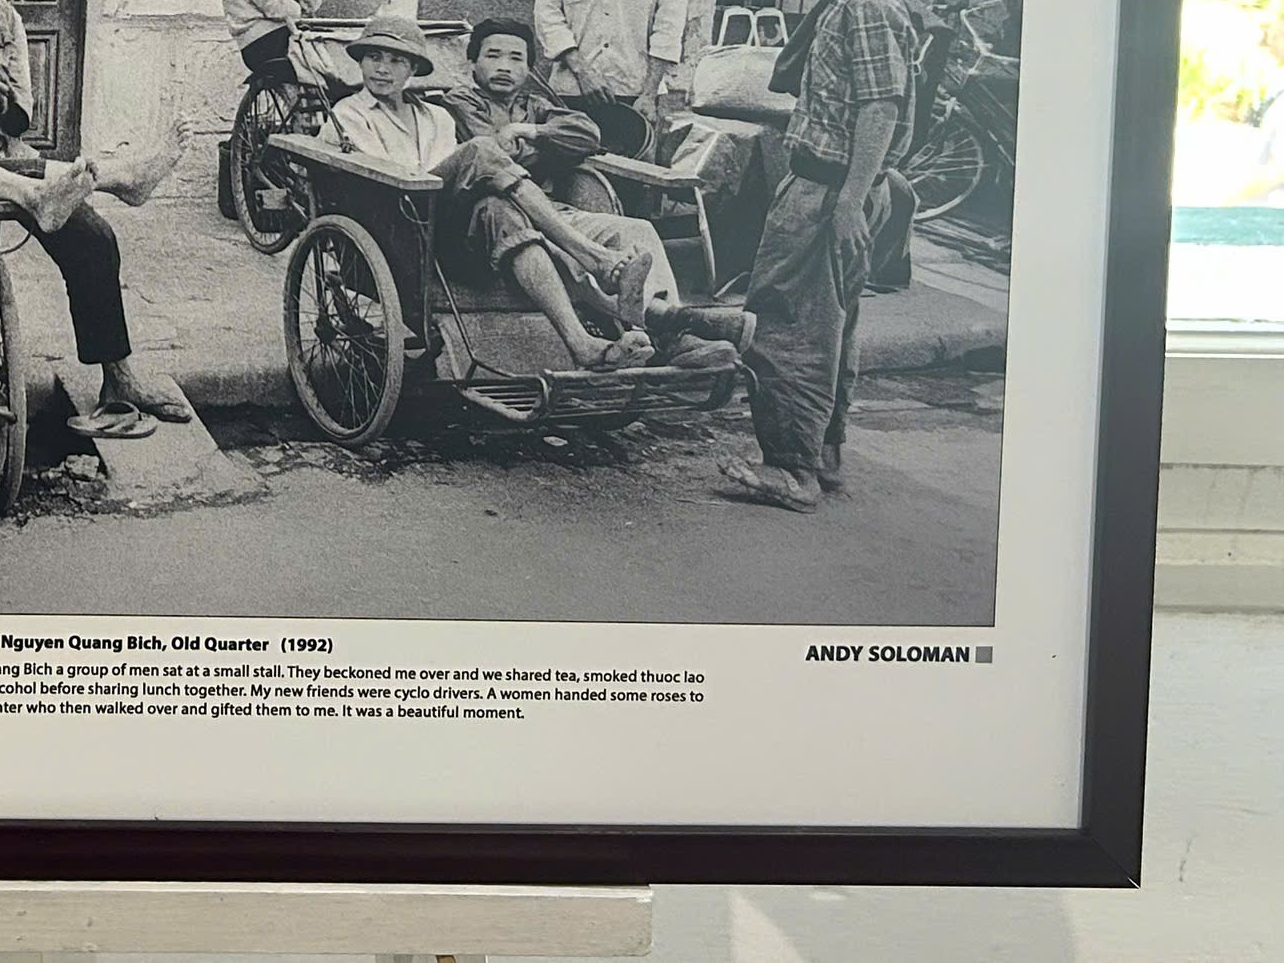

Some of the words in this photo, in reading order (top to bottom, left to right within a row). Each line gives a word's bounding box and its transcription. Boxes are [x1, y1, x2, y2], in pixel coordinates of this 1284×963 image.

[1, 635, 64, 653] Nguyen
[68, 635, 123, 653] Quang
[127, 635, 167, 652] Bich,
[171, 636, 200, 650] Old
[204, 637, 269, 652] Quarter
[281, 637, 333, 654] (1992)
[805, 645, 863, 662] ANDY
[868, 645, 970, 663] SOLOMAN
[24, 662, 52, 675] Bich
[56, 666, 63, 675] a
[66, 666, 108, 679] group
[112, 663, 126, 676] of
[129, 666, 159, 677] men
[162, 665, 183, 677] sat
[185, 665, 200, 677] at
[202, 667, 210, 677] a
[213, 664, 249, 677] small
[252, 665, 284, 678] stall.
[288, 665, 321, 682] They
[324, 665, 391, 679] beckoned
[395, 670, 416, 680] me
[419, 670, 450, 680] over
[453, 667, 479, 680] and
[482, 671, 502, 681] we
[505, 668, 551, 681] shared
[555, 670, 580, 683] tea,
[583, 669, 637, 682] smoked
[640, 669, 680, 683] thuoc
[684, 670, 705, 683] lao
[40, 681, 85, 695] before
[88, 682, 138, 698] sharing
[142, 682, 180, 696] lunch
[184, 683, 247, 699] together.
[250, 684, 271, 700] My
[274, 687, 304, 697] new
[306, 684, 354, 698] friends
[357, 688, 391, 698] were
[394, 686, 430, 702] cyclo
[433, 686, 483, 700] drivers.
[486, 687, 497, 700] A
[500, 690, 550, 700] women
[554, 687, 606, 701] handed
[610, 692, 647, 701] some
[651, 692, 686, 702] roses
[689, 690, 704, 702] to
[26, 700, 56, 714] who
[59, 701, 91, 714] then
[95, 701, 143, 715] walked
[147, 705, 178, 715] over
[181, 702, 207, 715] and
[210, 702, 252, 718] gifted
[255, 703, 291, 716] them
[295, 705, 310, 716] to
[314, 707, 338, 717] me.
[342, 704, 352, 717] It
[355, 707, 382, 717] was
[385, 708, 393, 717] a
[398, 704, 459, 718] beautiful
[463, 707, 524, 719] moment.
